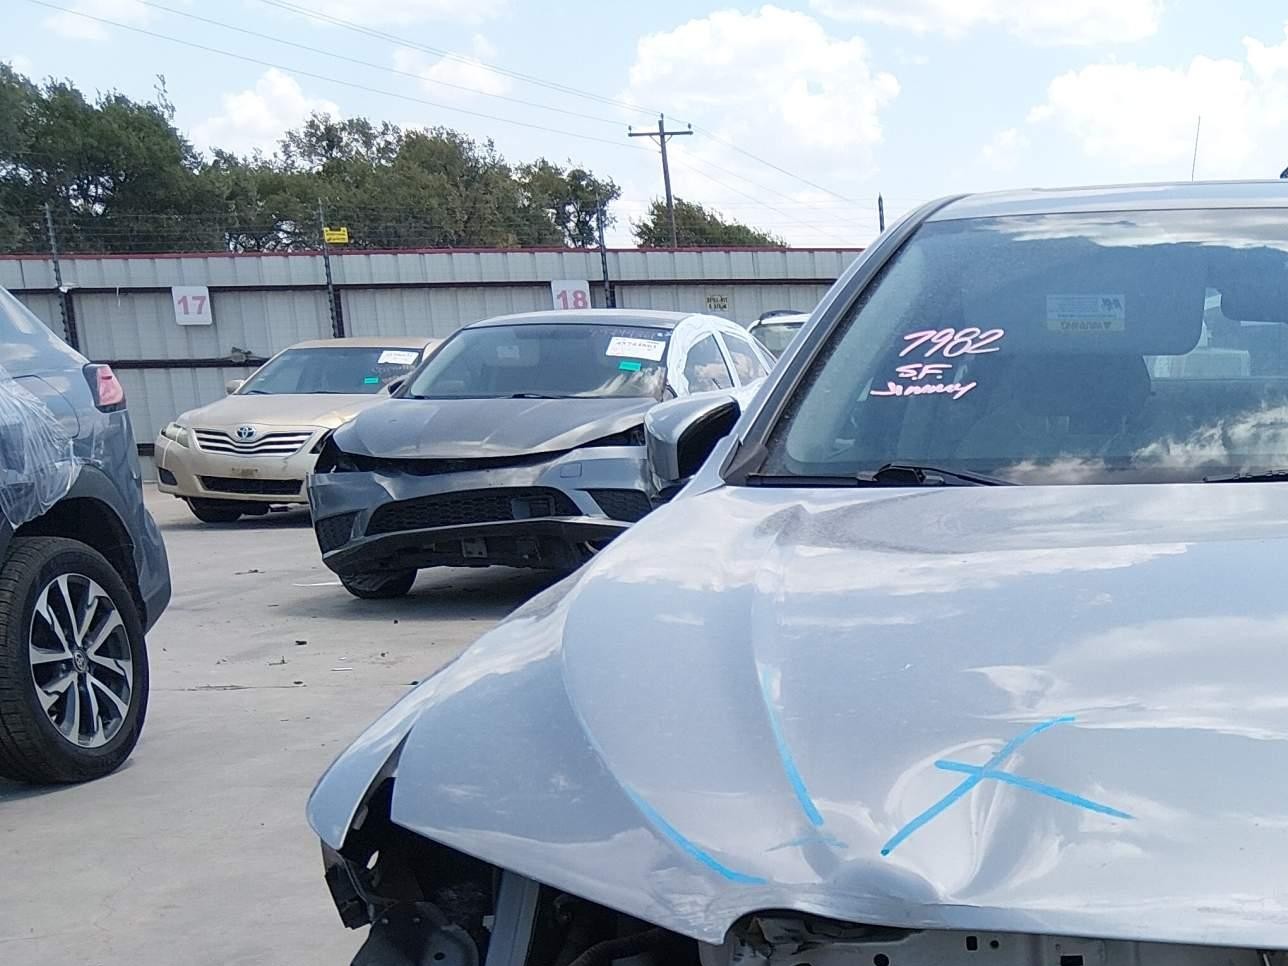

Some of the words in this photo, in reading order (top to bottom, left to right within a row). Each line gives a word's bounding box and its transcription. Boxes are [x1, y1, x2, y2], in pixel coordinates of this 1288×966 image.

[177, 295, 207, 315] 17
[557, 290, 588, 309] 18
[899, 327, 1004, 357] 7982
